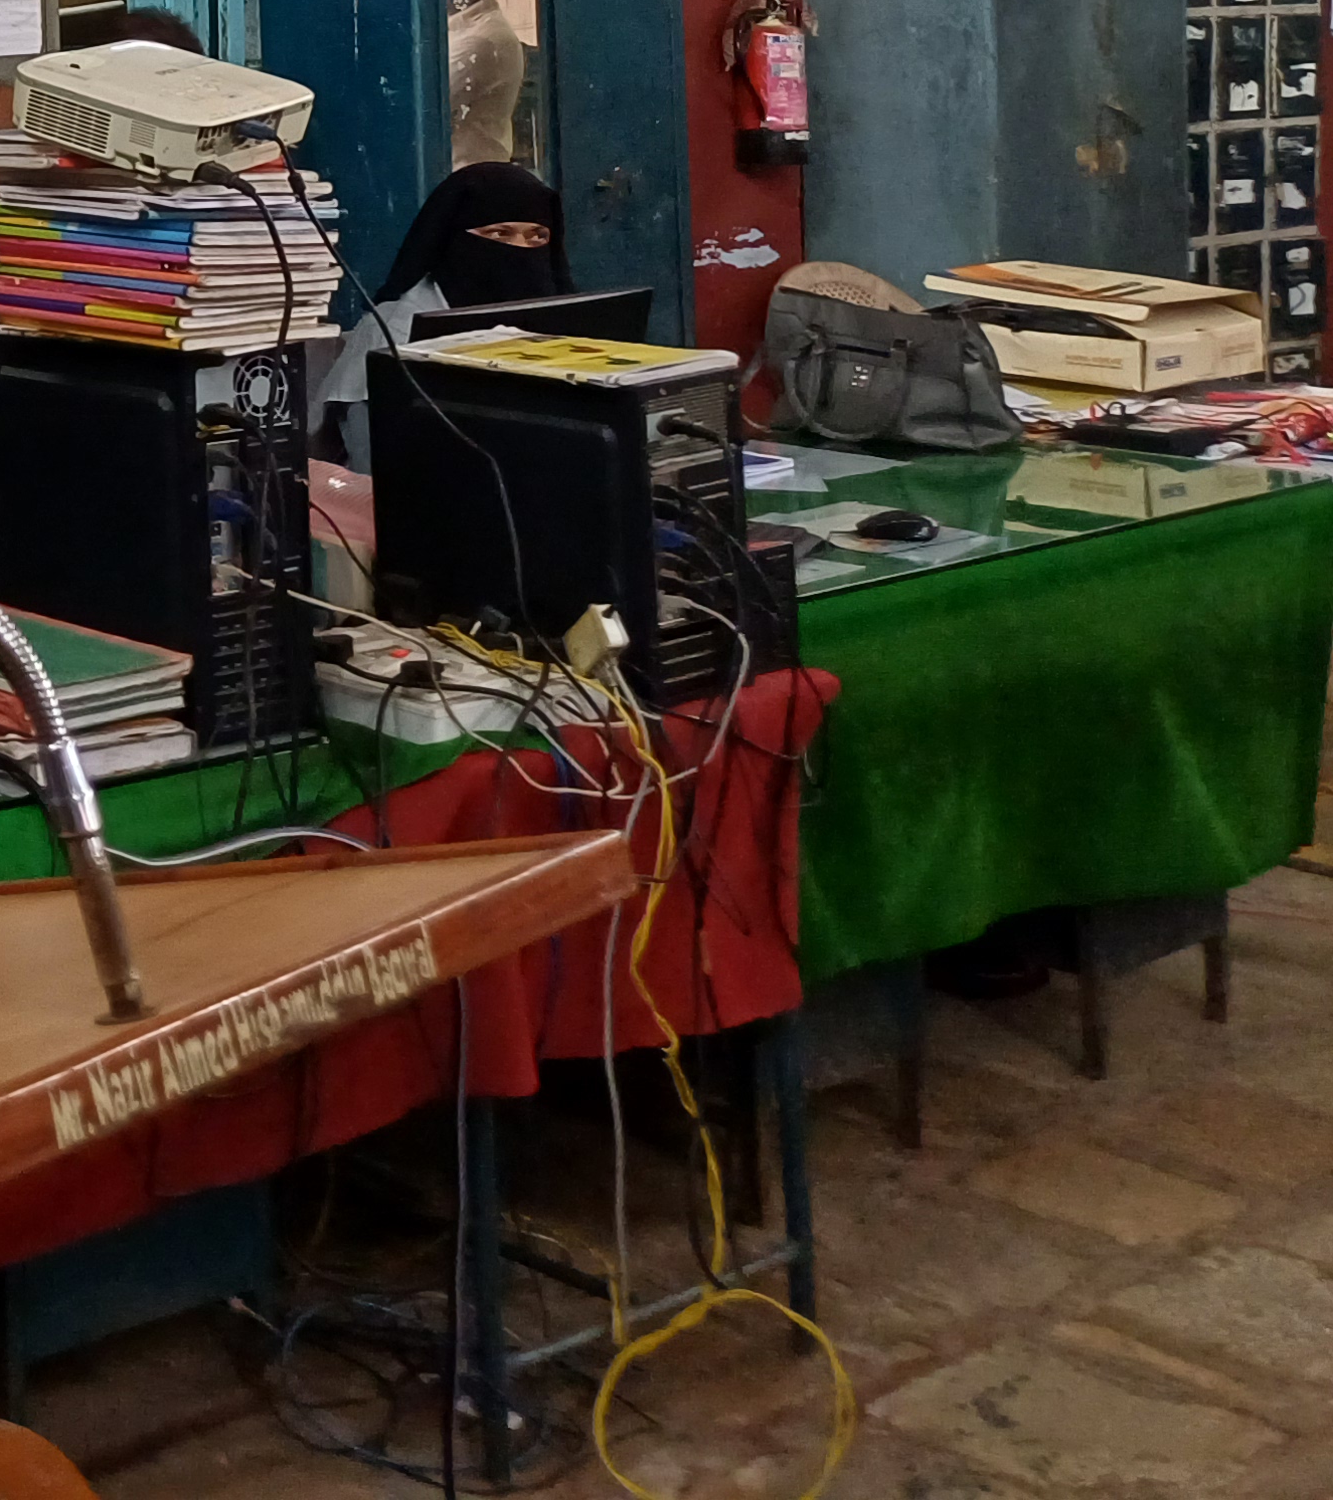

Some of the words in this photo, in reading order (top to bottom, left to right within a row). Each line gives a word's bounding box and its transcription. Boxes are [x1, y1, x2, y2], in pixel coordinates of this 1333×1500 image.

[47, 1085, 96, 1150] Mr.
[85, 1047, 156, 1127] Nazir
[156, 1006, 239, 1100] Ahmed
